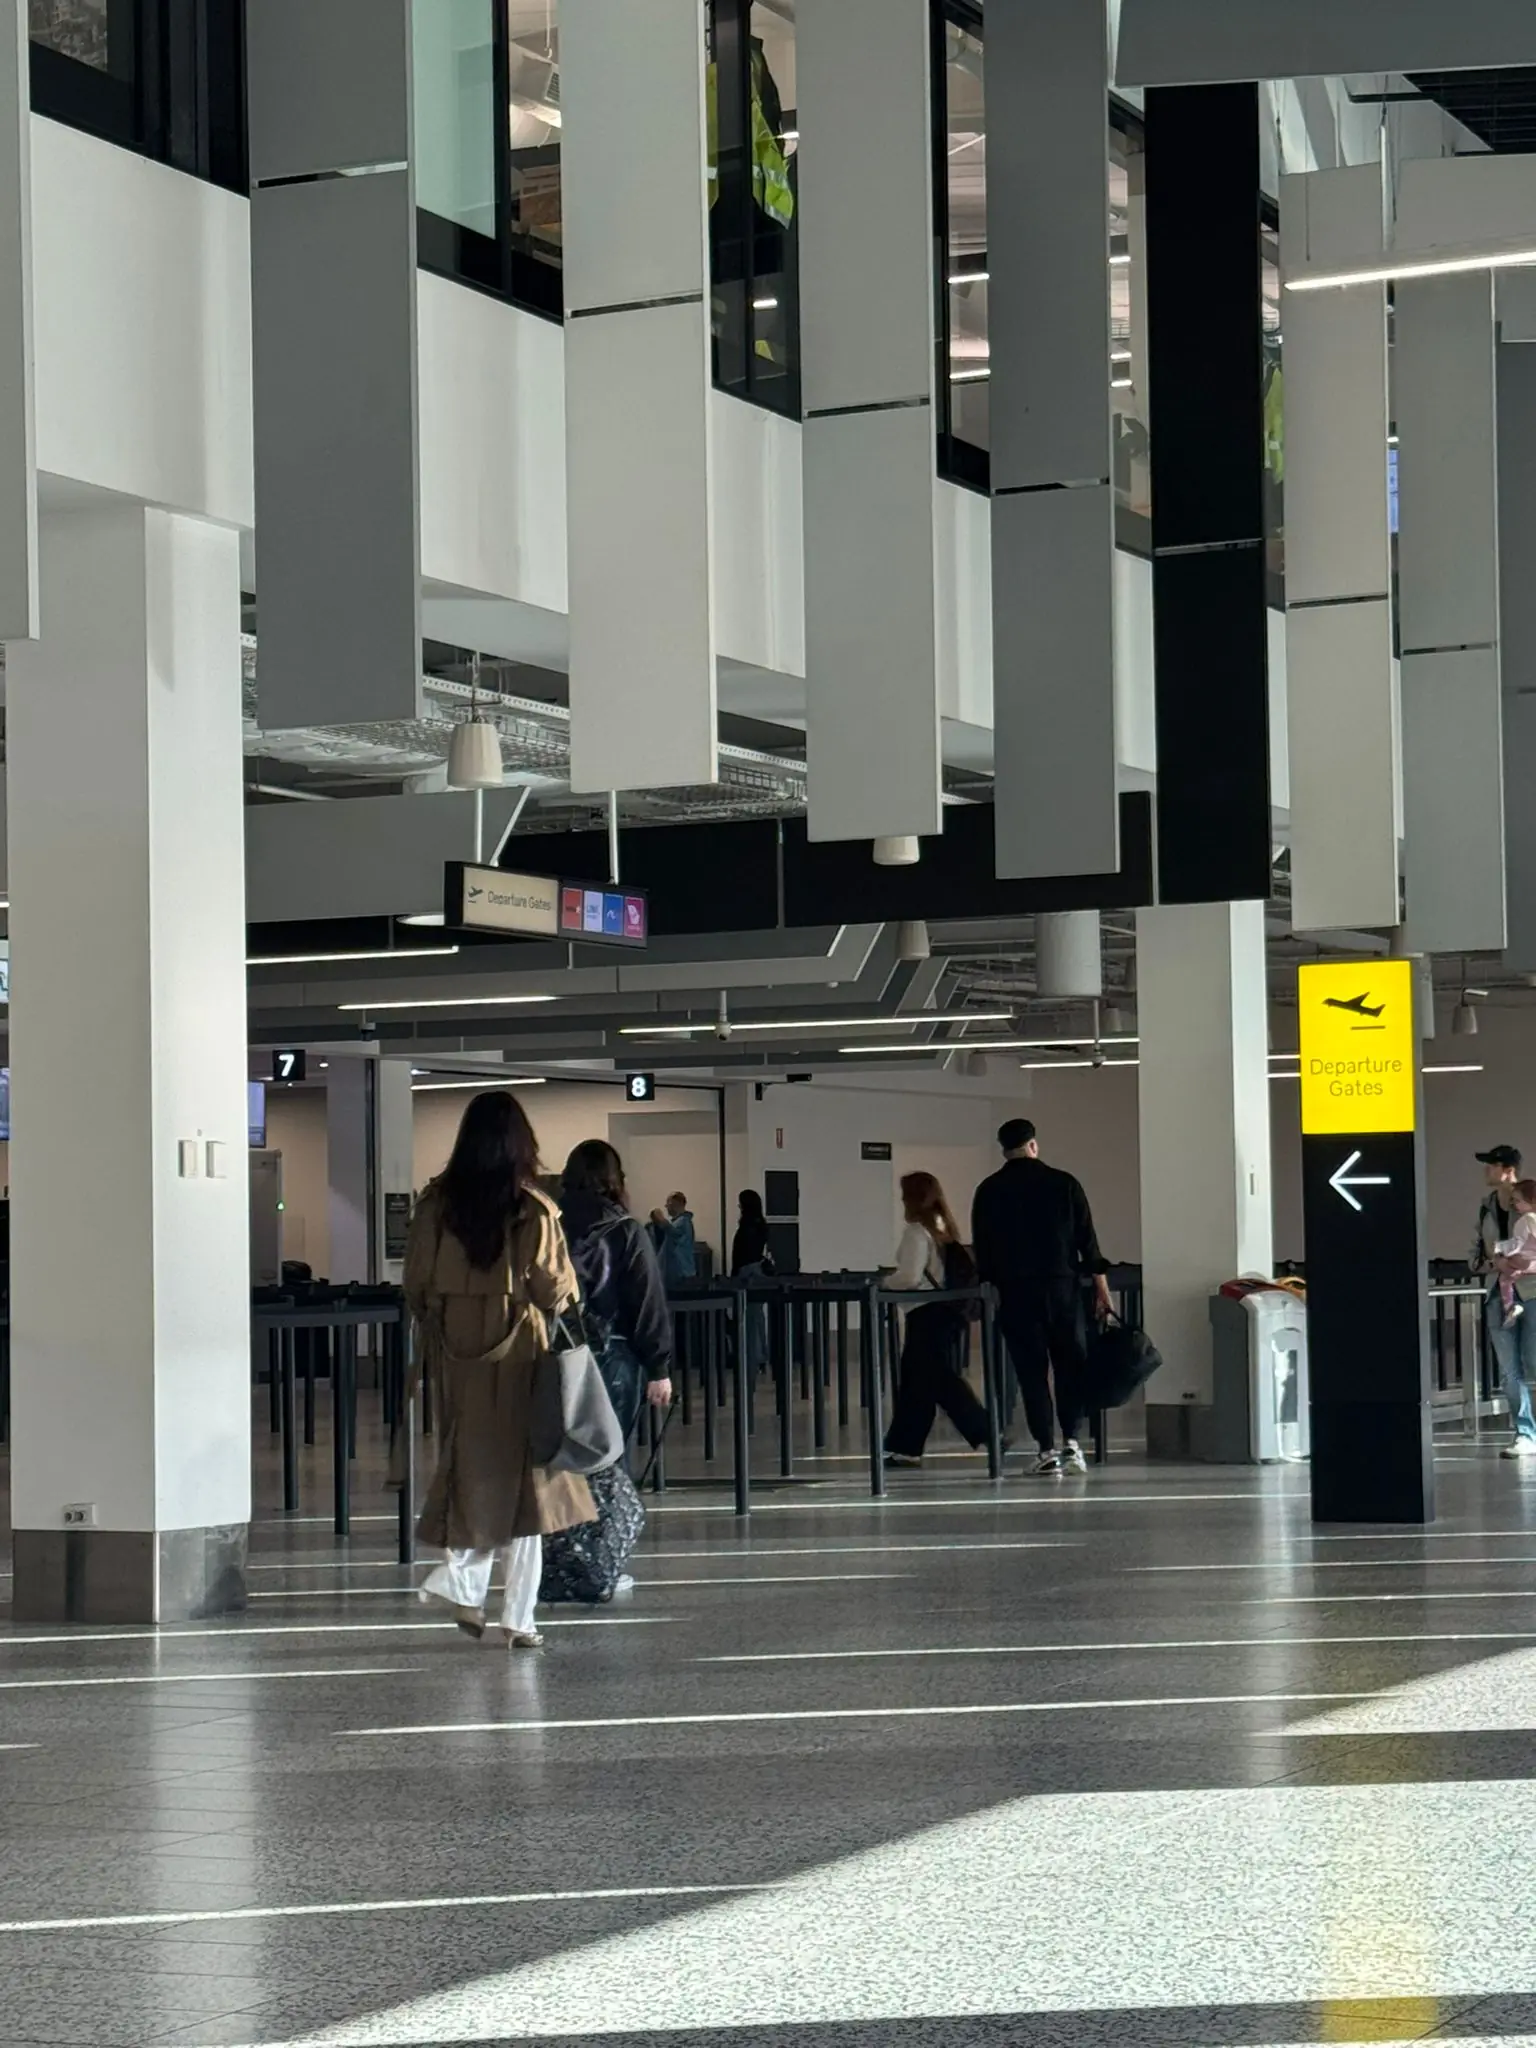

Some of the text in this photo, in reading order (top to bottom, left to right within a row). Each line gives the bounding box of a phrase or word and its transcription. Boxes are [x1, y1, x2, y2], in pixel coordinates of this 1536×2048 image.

[488, 890, 527, 908] Departure
[528, 896, 552, 911] Gates
[279, 1054, 295, 1077] 7
[1310, 1056, 1403, 1077] Departure
[631, 1076, 646, 1097] 8
[1329, 1079, 1384, 1097] Gates
